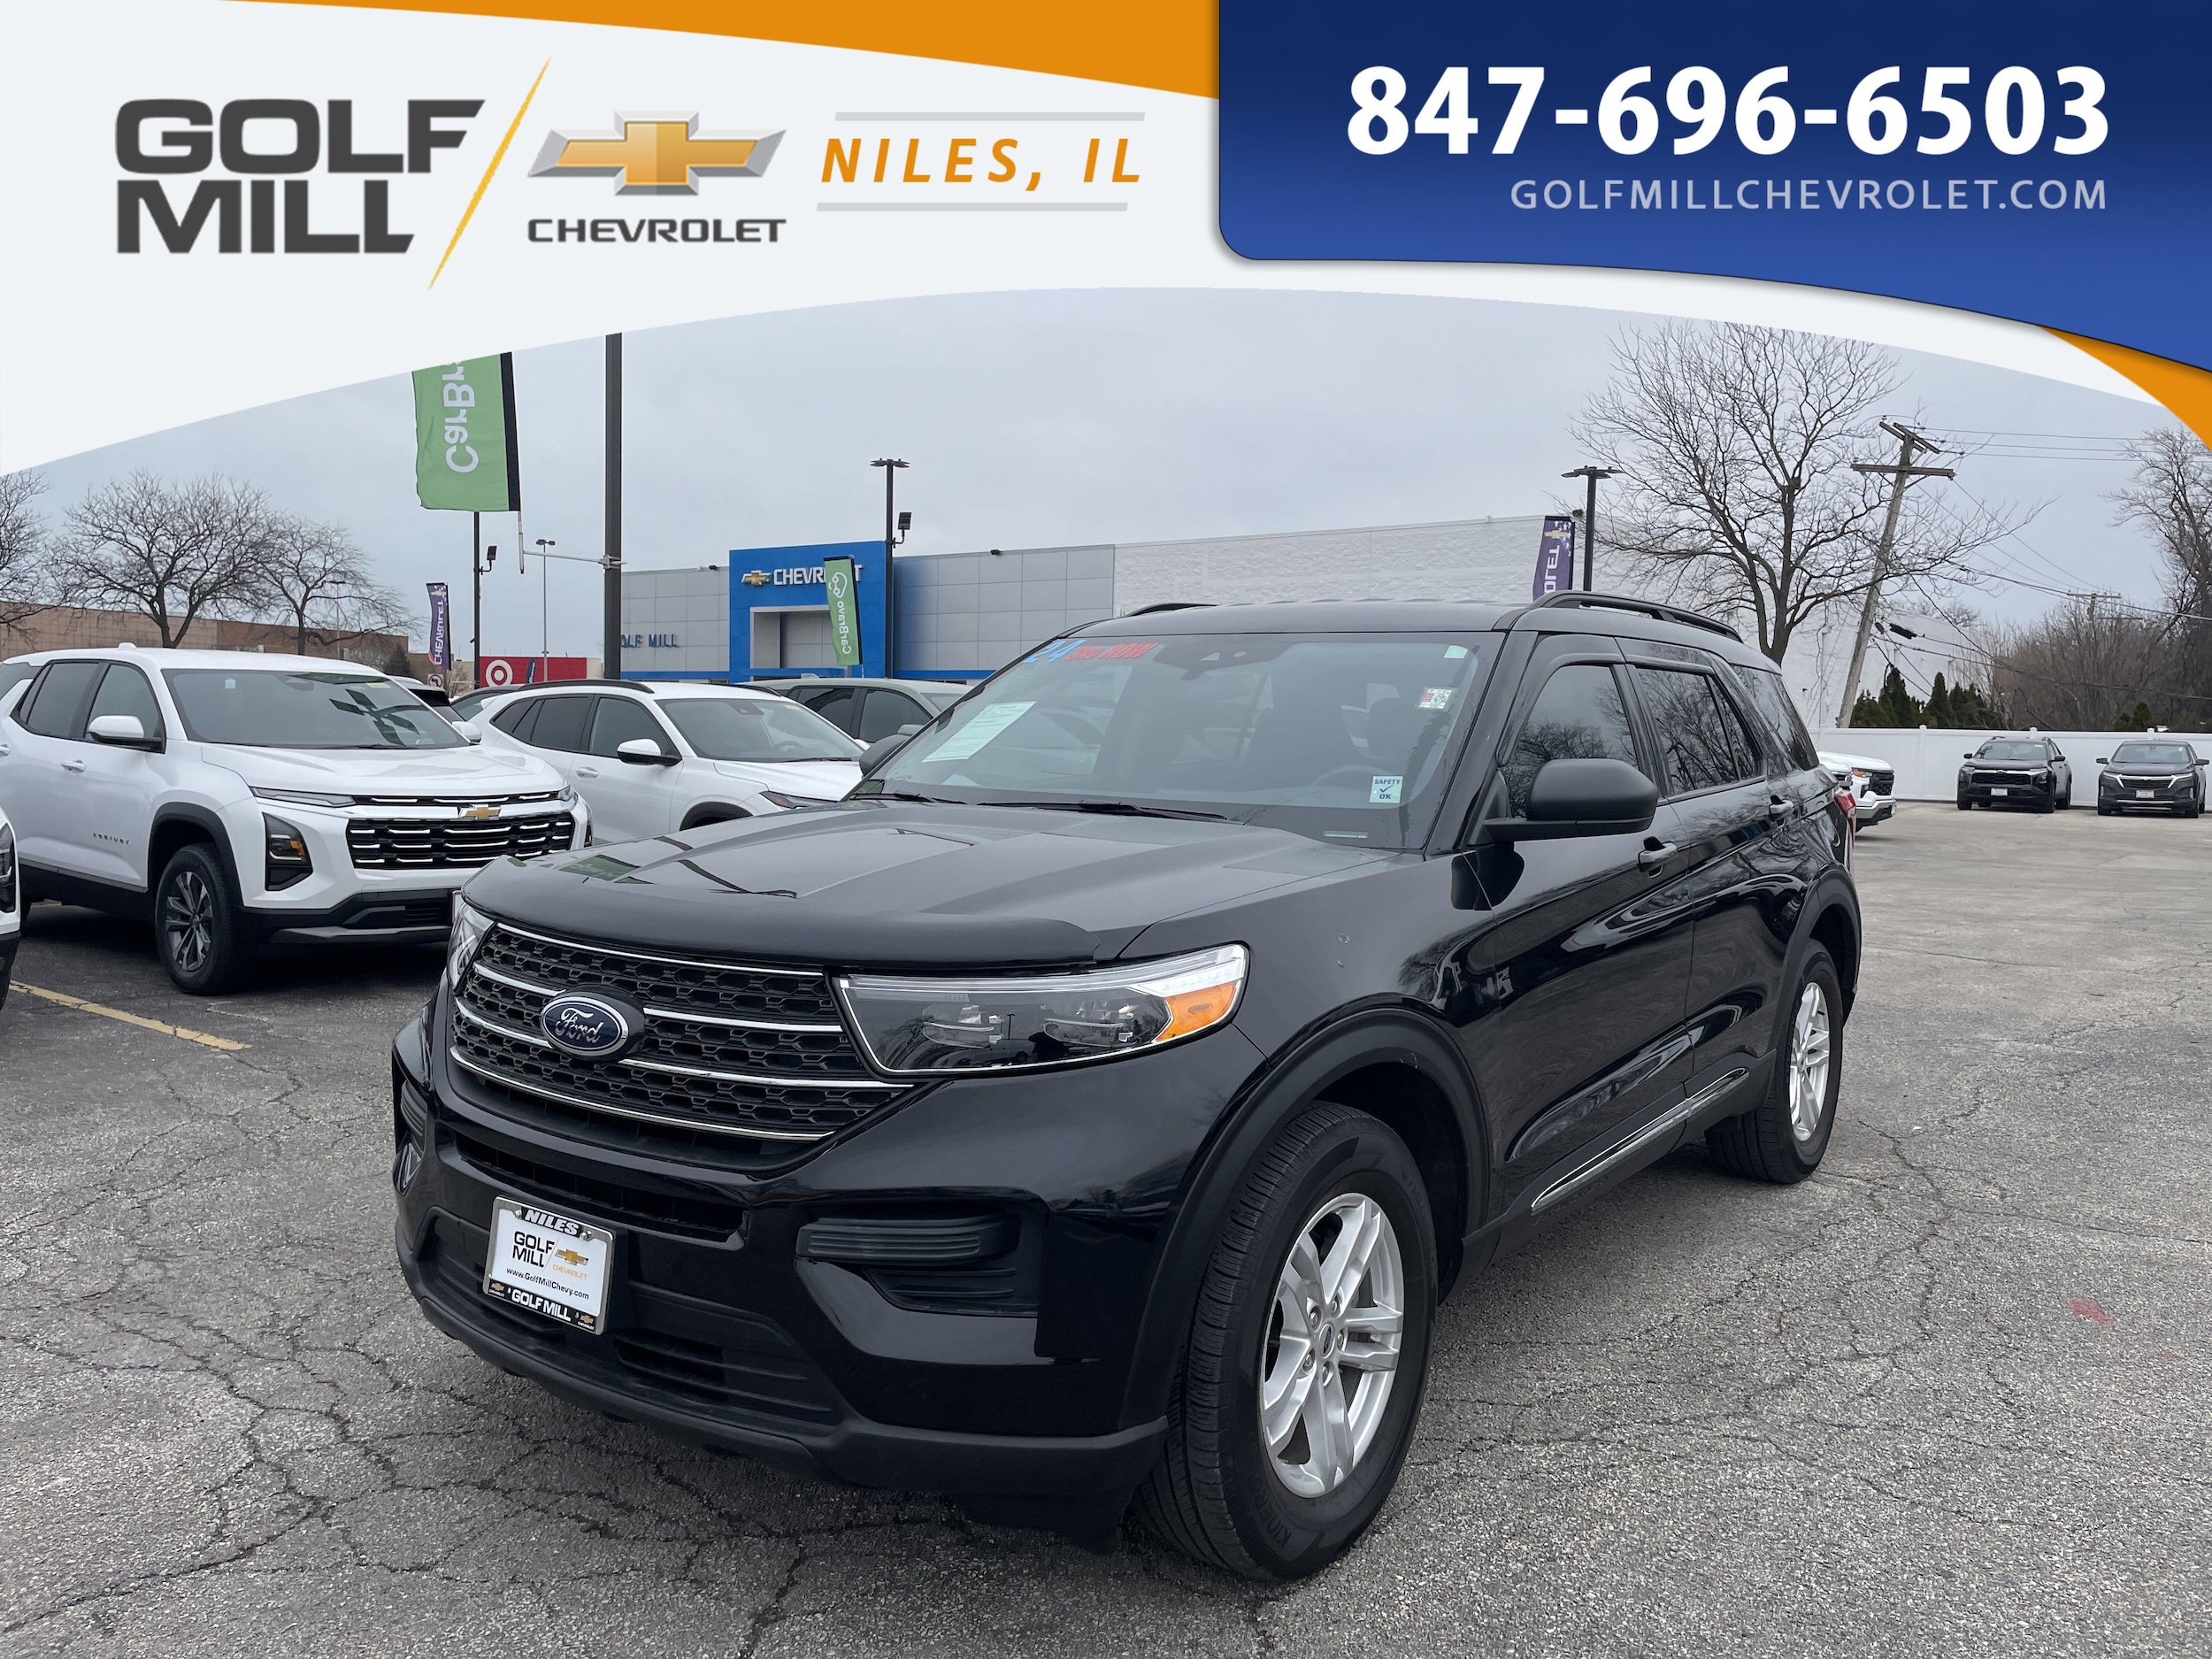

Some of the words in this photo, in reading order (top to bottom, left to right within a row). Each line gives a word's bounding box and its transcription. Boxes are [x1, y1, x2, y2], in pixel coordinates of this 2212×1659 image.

[773, 565, 863, 586] CHEVRT
[620, 634, 642, 648] OLF
[649, 634, 678, 648] MILL
[554, 1007, 604, 1044] Ford
[524, 1209, 580, 1236] NILES
[513, 1231, 556, 1254] GOLF
[511, 1245, 545, 1269] MILL
[506, 1267, 589, 1300] www.GolfMillChevy.com
[552, 1264, 588, 1280] CHEVROLET
[511, 1289, 542, 1312] GOLF
[542, 1300, 572, 1322] MILL
